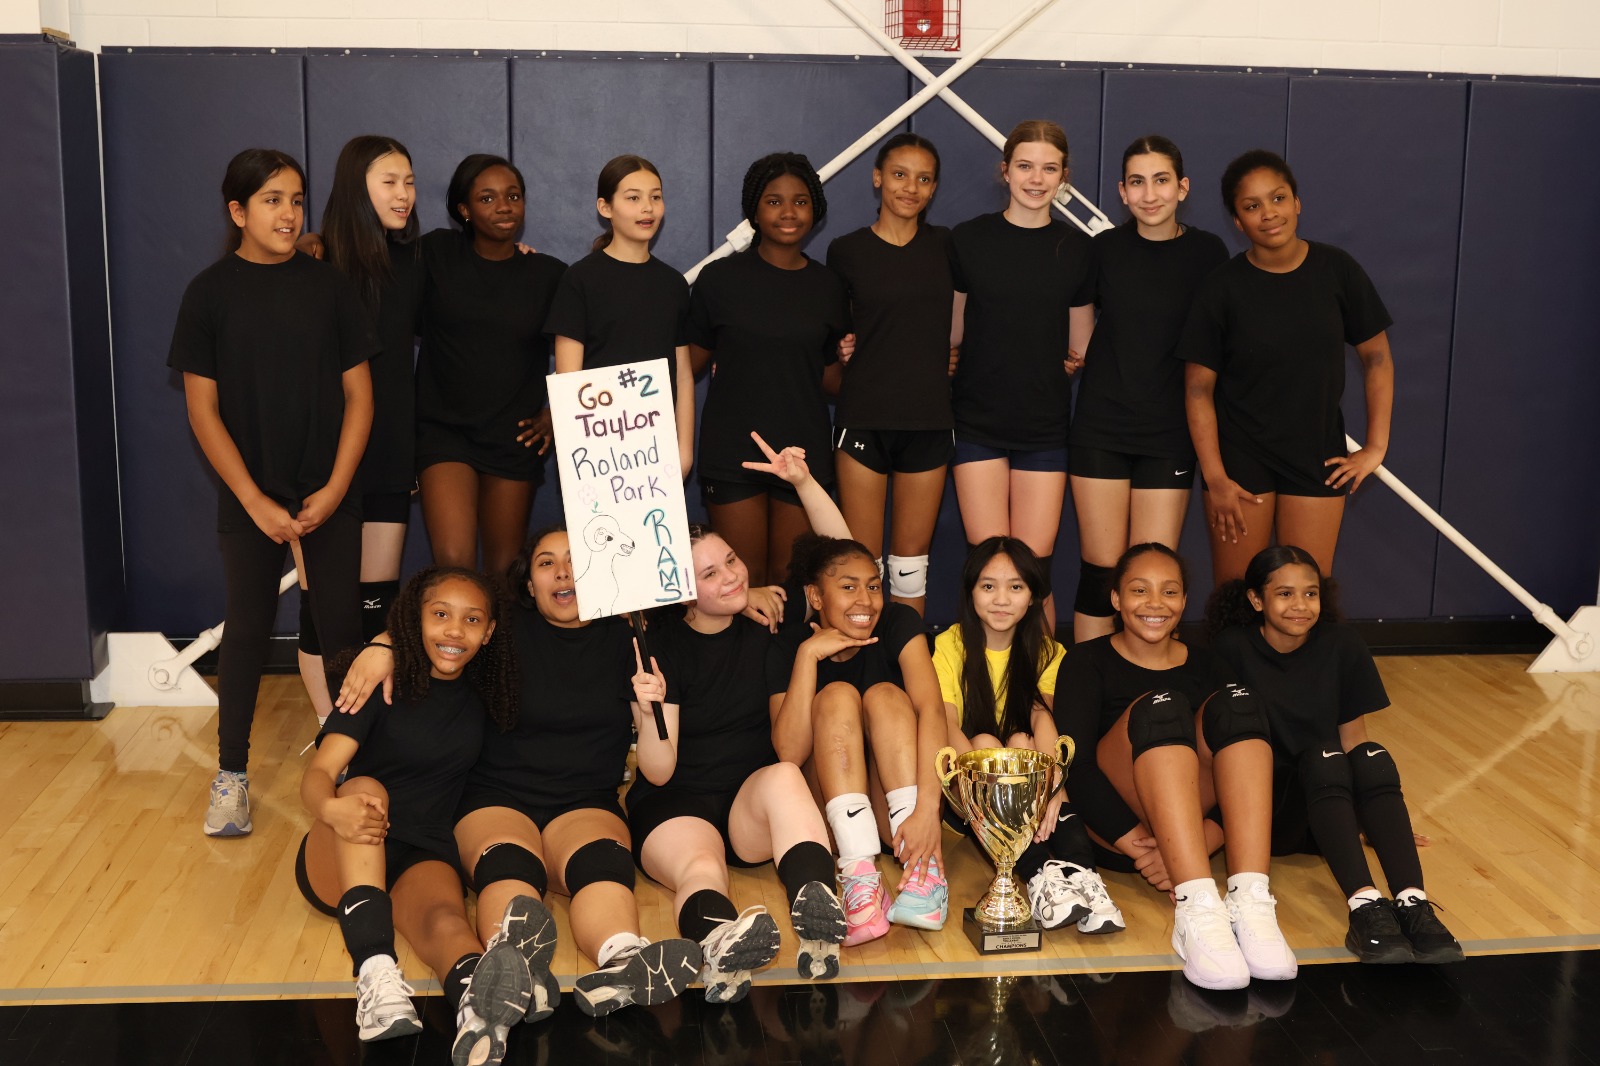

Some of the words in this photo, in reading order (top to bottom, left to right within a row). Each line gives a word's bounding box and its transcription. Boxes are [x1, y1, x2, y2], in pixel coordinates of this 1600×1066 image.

[578, 383, 612, 410] Go
[618, 368, 660, 398] #2
[572, 436, 659, 480] Roland
